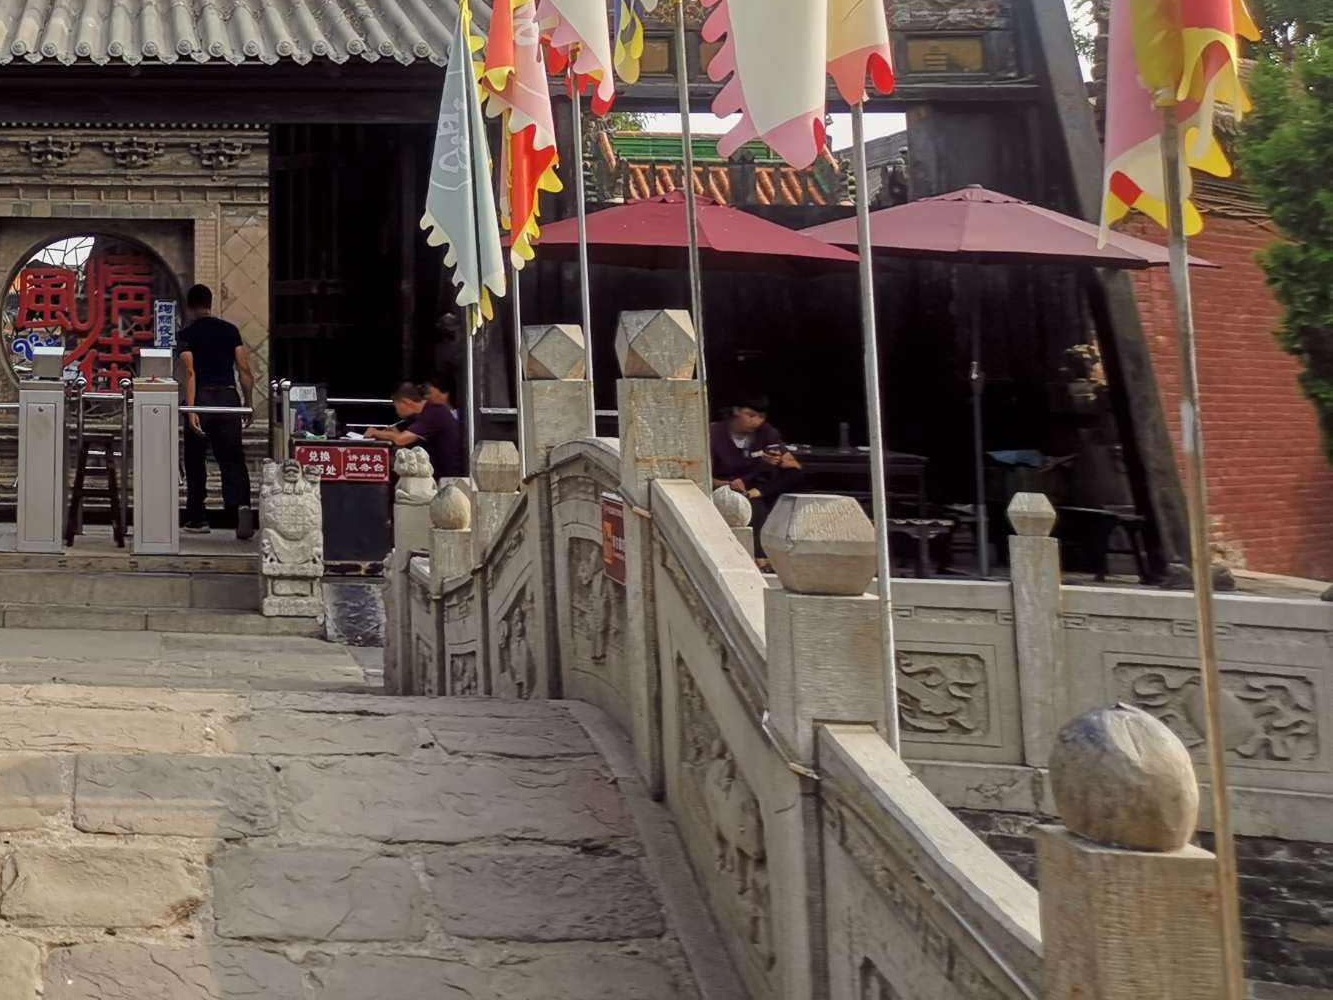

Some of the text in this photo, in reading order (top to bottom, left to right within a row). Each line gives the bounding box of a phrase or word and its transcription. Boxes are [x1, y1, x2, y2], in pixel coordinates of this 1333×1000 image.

[347, 454, 382, 463] 讲解员
[346, 463, 385, 472] 服务台
